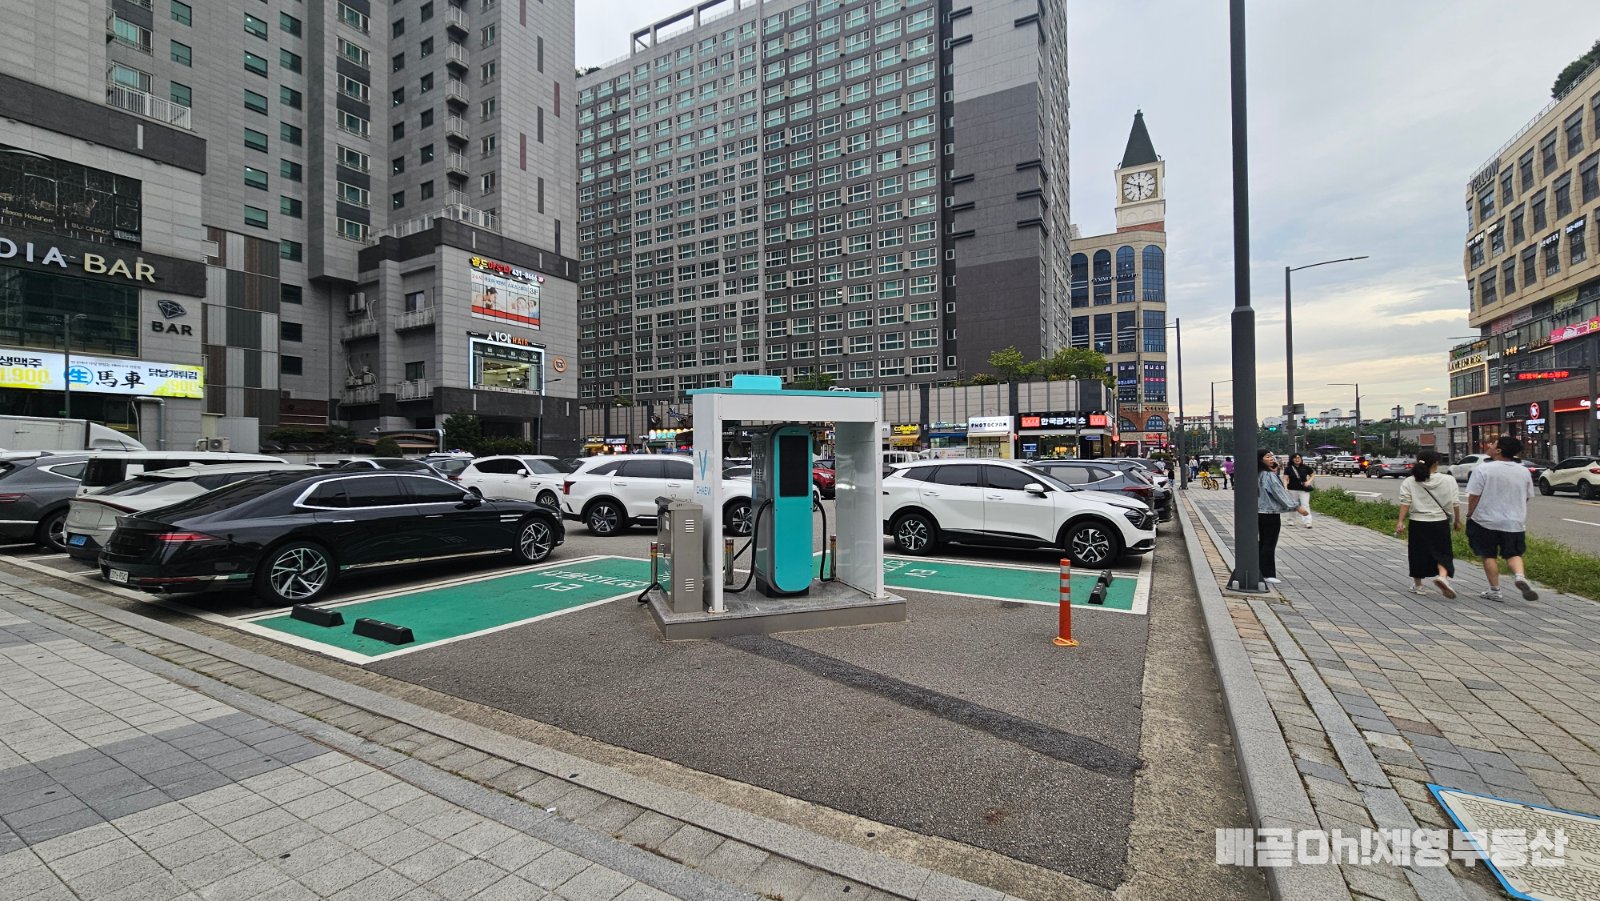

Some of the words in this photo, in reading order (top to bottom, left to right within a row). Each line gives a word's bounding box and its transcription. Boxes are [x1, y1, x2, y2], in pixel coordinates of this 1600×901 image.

[84, 252, 156, 283] BAR
[151, 320, 193, 336] BAR
[1041, 416, 1086, 426] 한국금거래소
